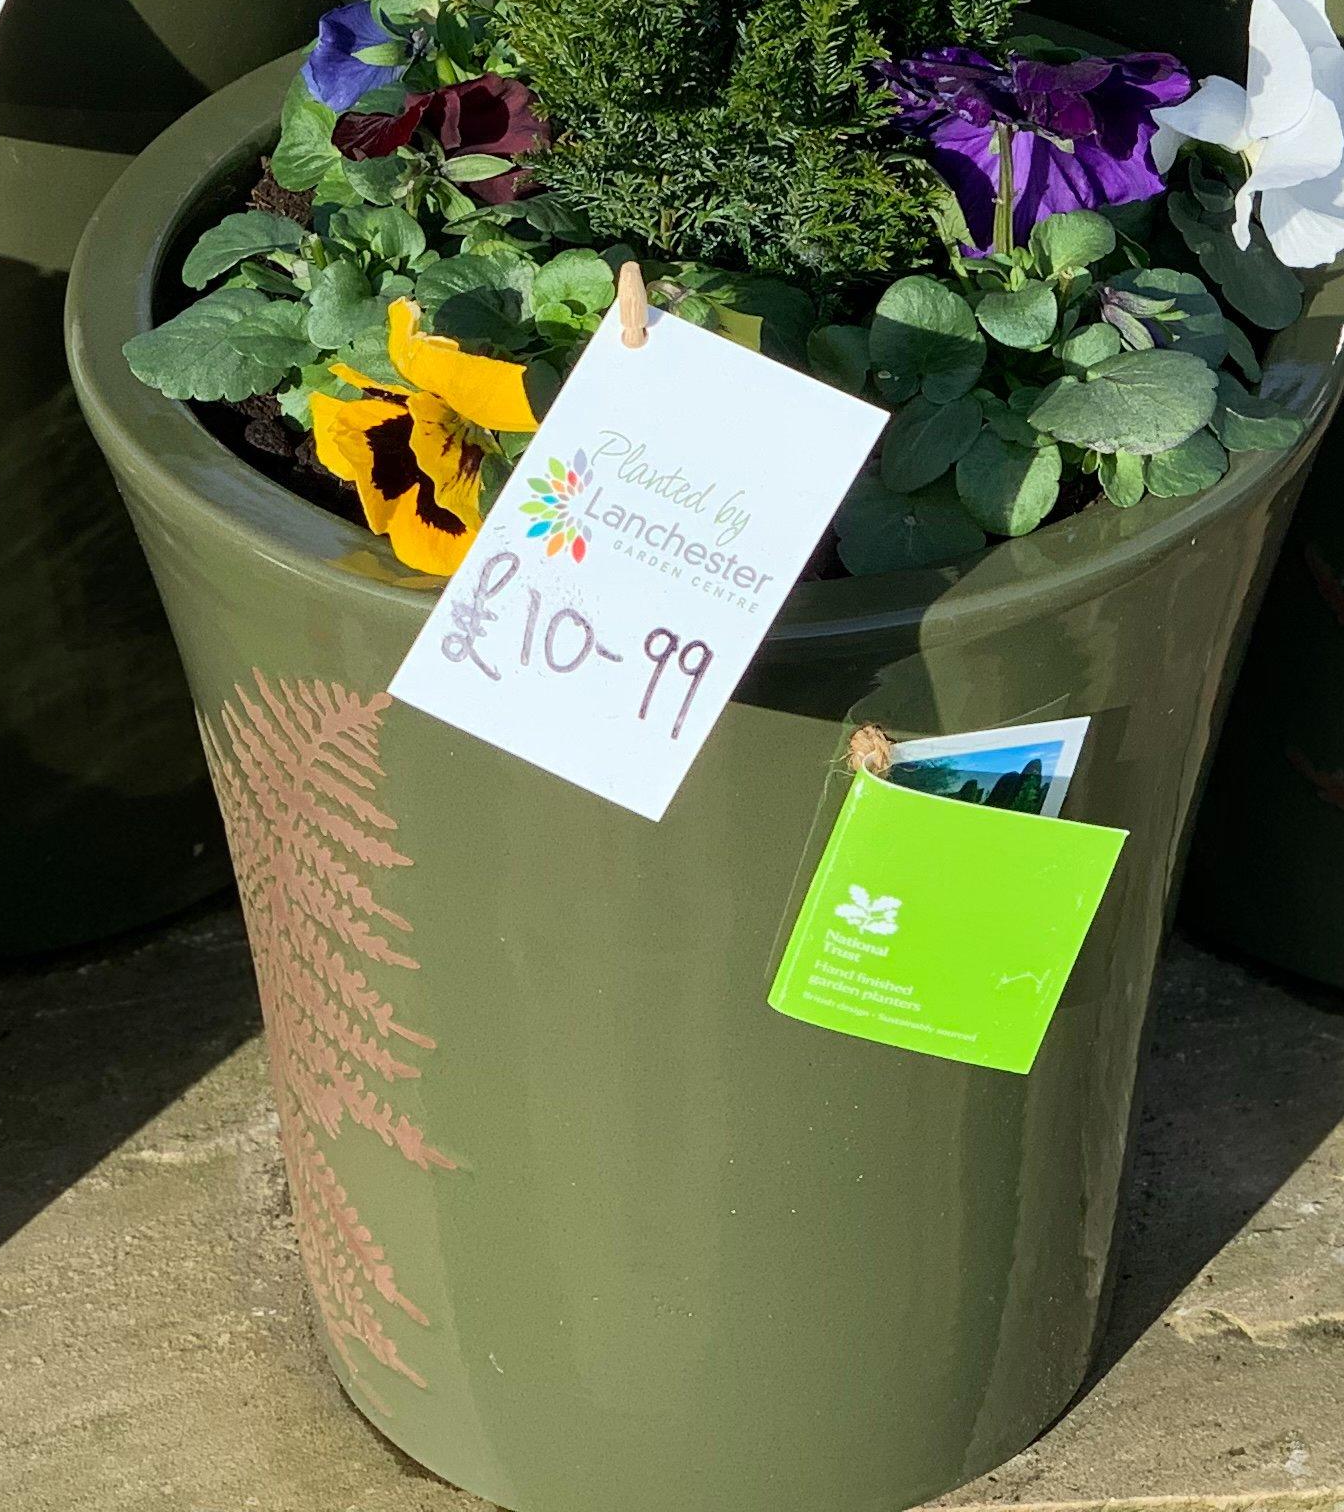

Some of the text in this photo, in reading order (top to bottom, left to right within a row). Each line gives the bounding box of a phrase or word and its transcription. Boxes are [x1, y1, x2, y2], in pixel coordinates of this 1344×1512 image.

[591, 430, 751, 547] Planted by
[584, 486, 774, 594] Lanchester
[613, 539, 759, 614] GARDEN CENTRE
[823, 941, 861, 963] Trust
[825, 929, 890, 957] National
[808, 974, 922, 1013] garden planters
[814, 959, 914, 996] Hand finished
